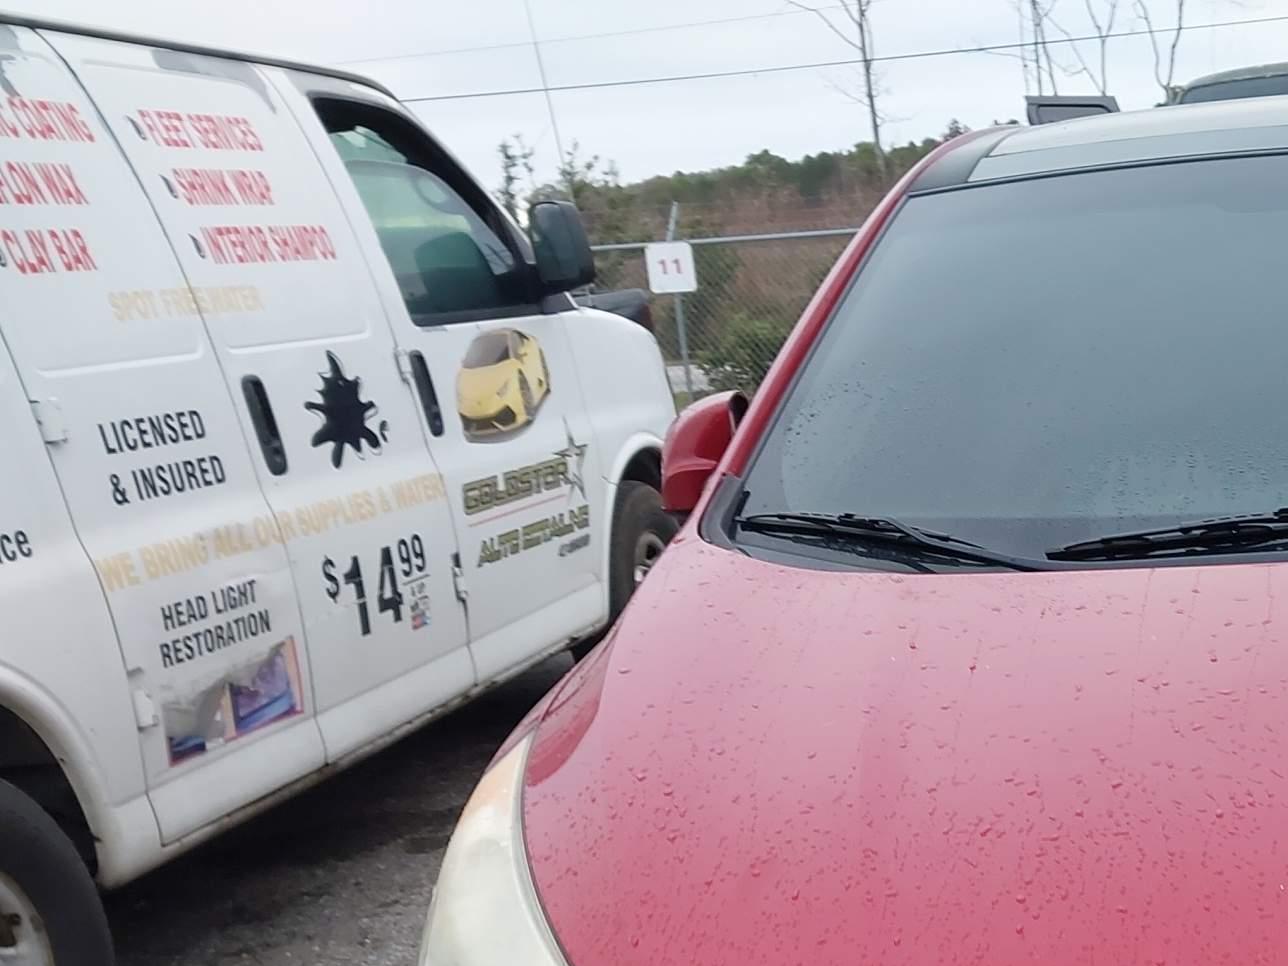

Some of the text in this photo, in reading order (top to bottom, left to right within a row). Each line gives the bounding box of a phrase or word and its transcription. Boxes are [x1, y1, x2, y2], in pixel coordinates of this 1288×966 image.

[7, 97, 95, 142] COATING
[138, 109, 197, 148] FLEET
[31, 162, 90, 205] WAX
[1, 228, 99, 274] CLAY BAR
[657, 258, 683, 275] 11
[107, 290, 158, 321] SPOT
[97, 409, 206, 454] LICENSED
[109, 455, 226, 505] & INSURED
[96, 552, 140, 592] WE
[139, 535, 208, 580] BRING
[211, 522, 255, 559] ALL
[254, 511, 297, 547] OUR
[161, 579, 257, 632] HEAD LIGHT
[159, 609, 272, 669] RESTORATION
